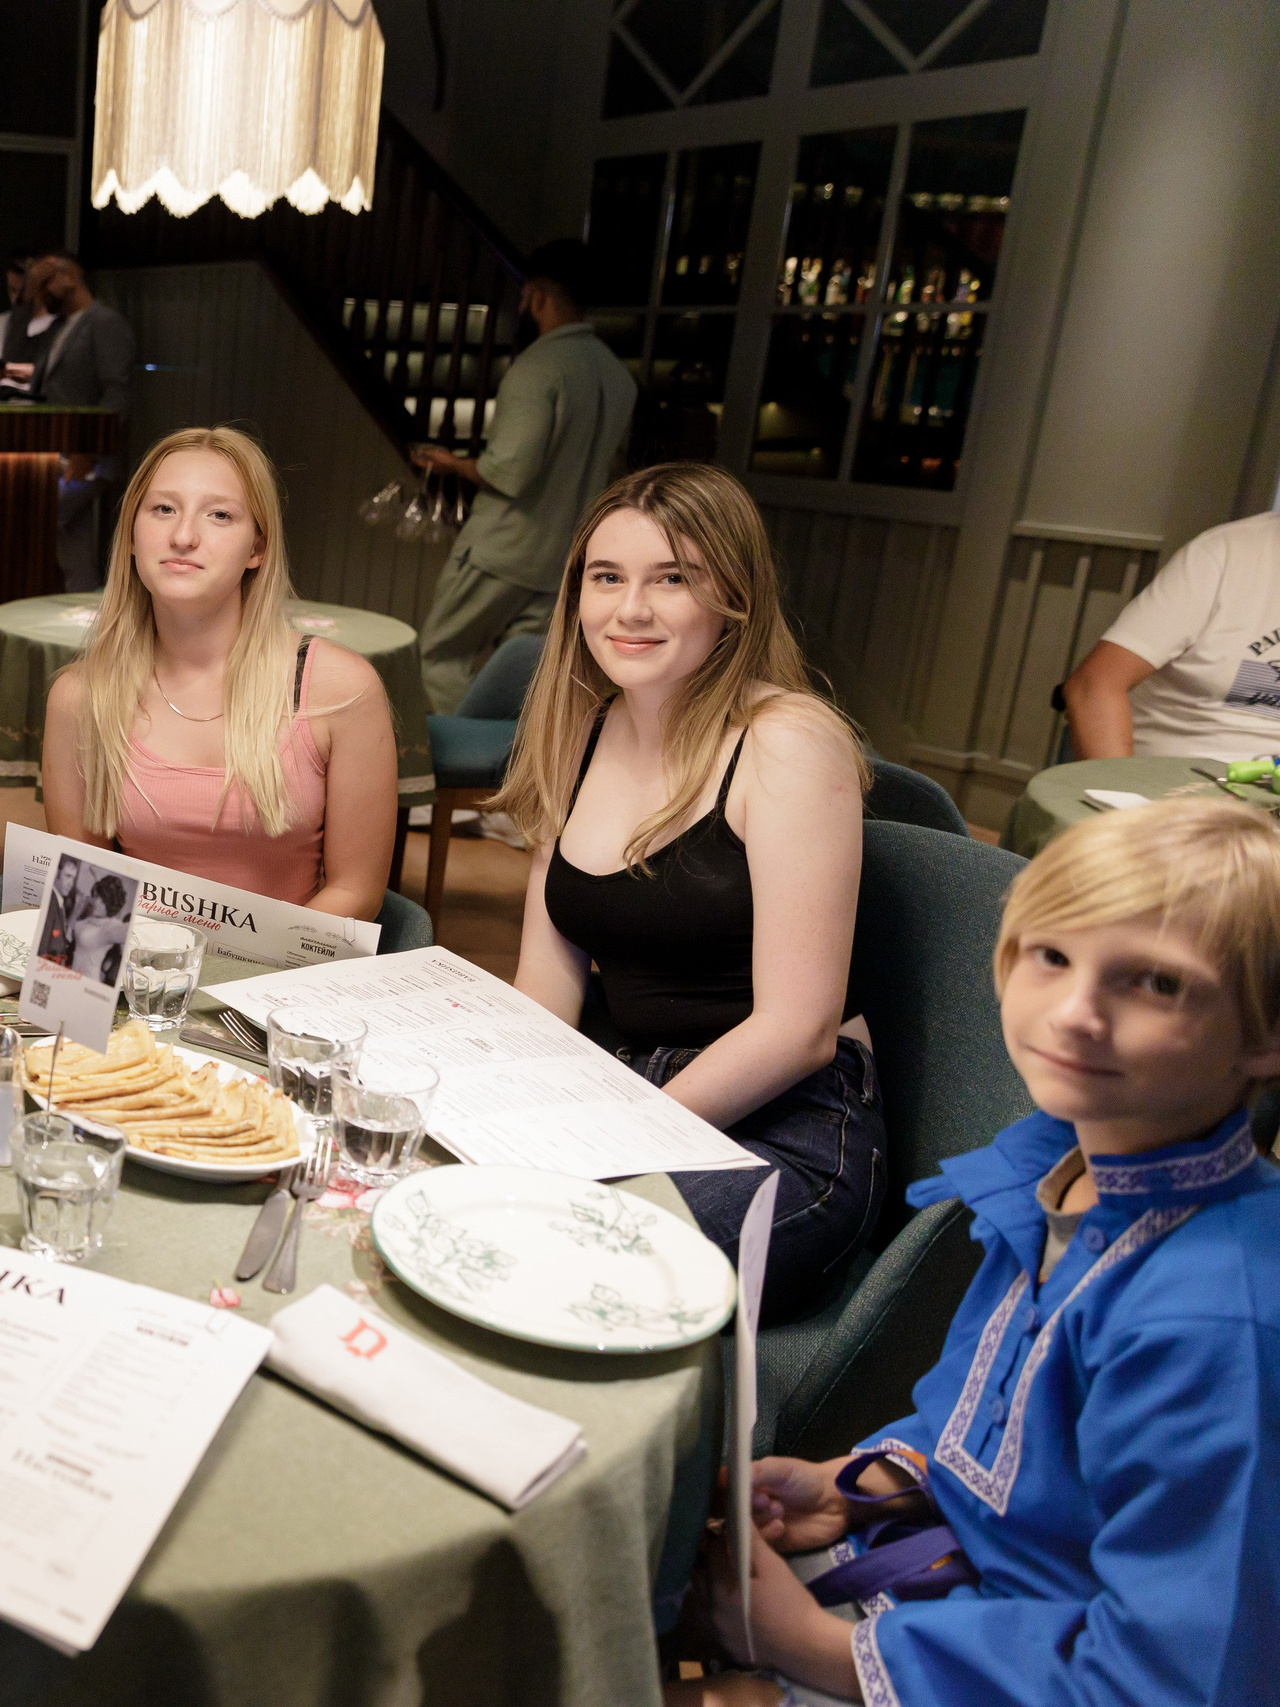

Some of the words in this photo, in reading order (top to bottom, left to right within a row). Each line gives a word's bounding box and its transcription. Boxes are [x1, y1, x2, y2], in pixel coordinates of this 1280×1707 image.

[1246, 627, 1280, 656] PA
[183, 914, 222, 931] меню
[301, 942, 336, 958] КОКТЕЙЛИ
